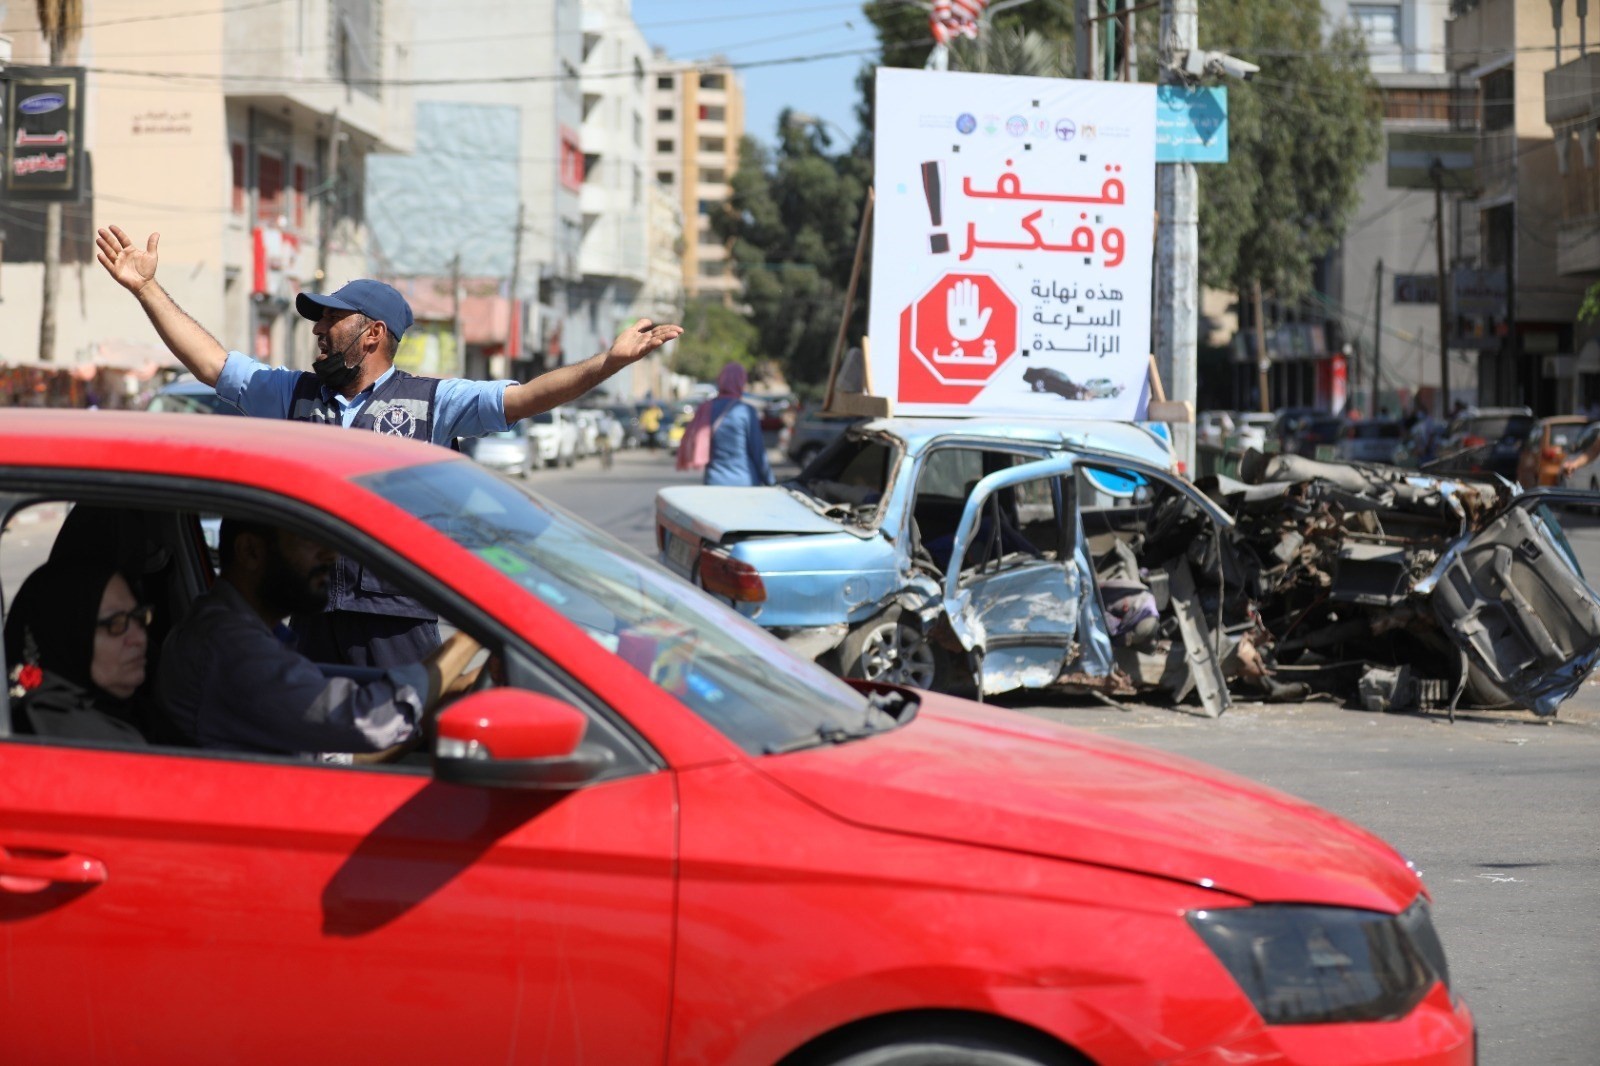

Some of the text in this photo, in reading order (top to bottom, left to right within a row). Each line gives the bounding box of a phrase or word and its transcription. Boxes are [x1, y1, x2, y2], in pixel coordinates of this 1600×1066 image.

[963, 158, 1125, 205] قف
[959, 209, 1125, 267] وفكر
[1031, 279, 1123, 304] هذه نهاية
[1033, 306, 1120, 330] السرعة
[932, 338, 997, 366] قف
[1033, 333, 1120, 358] الزائدة
